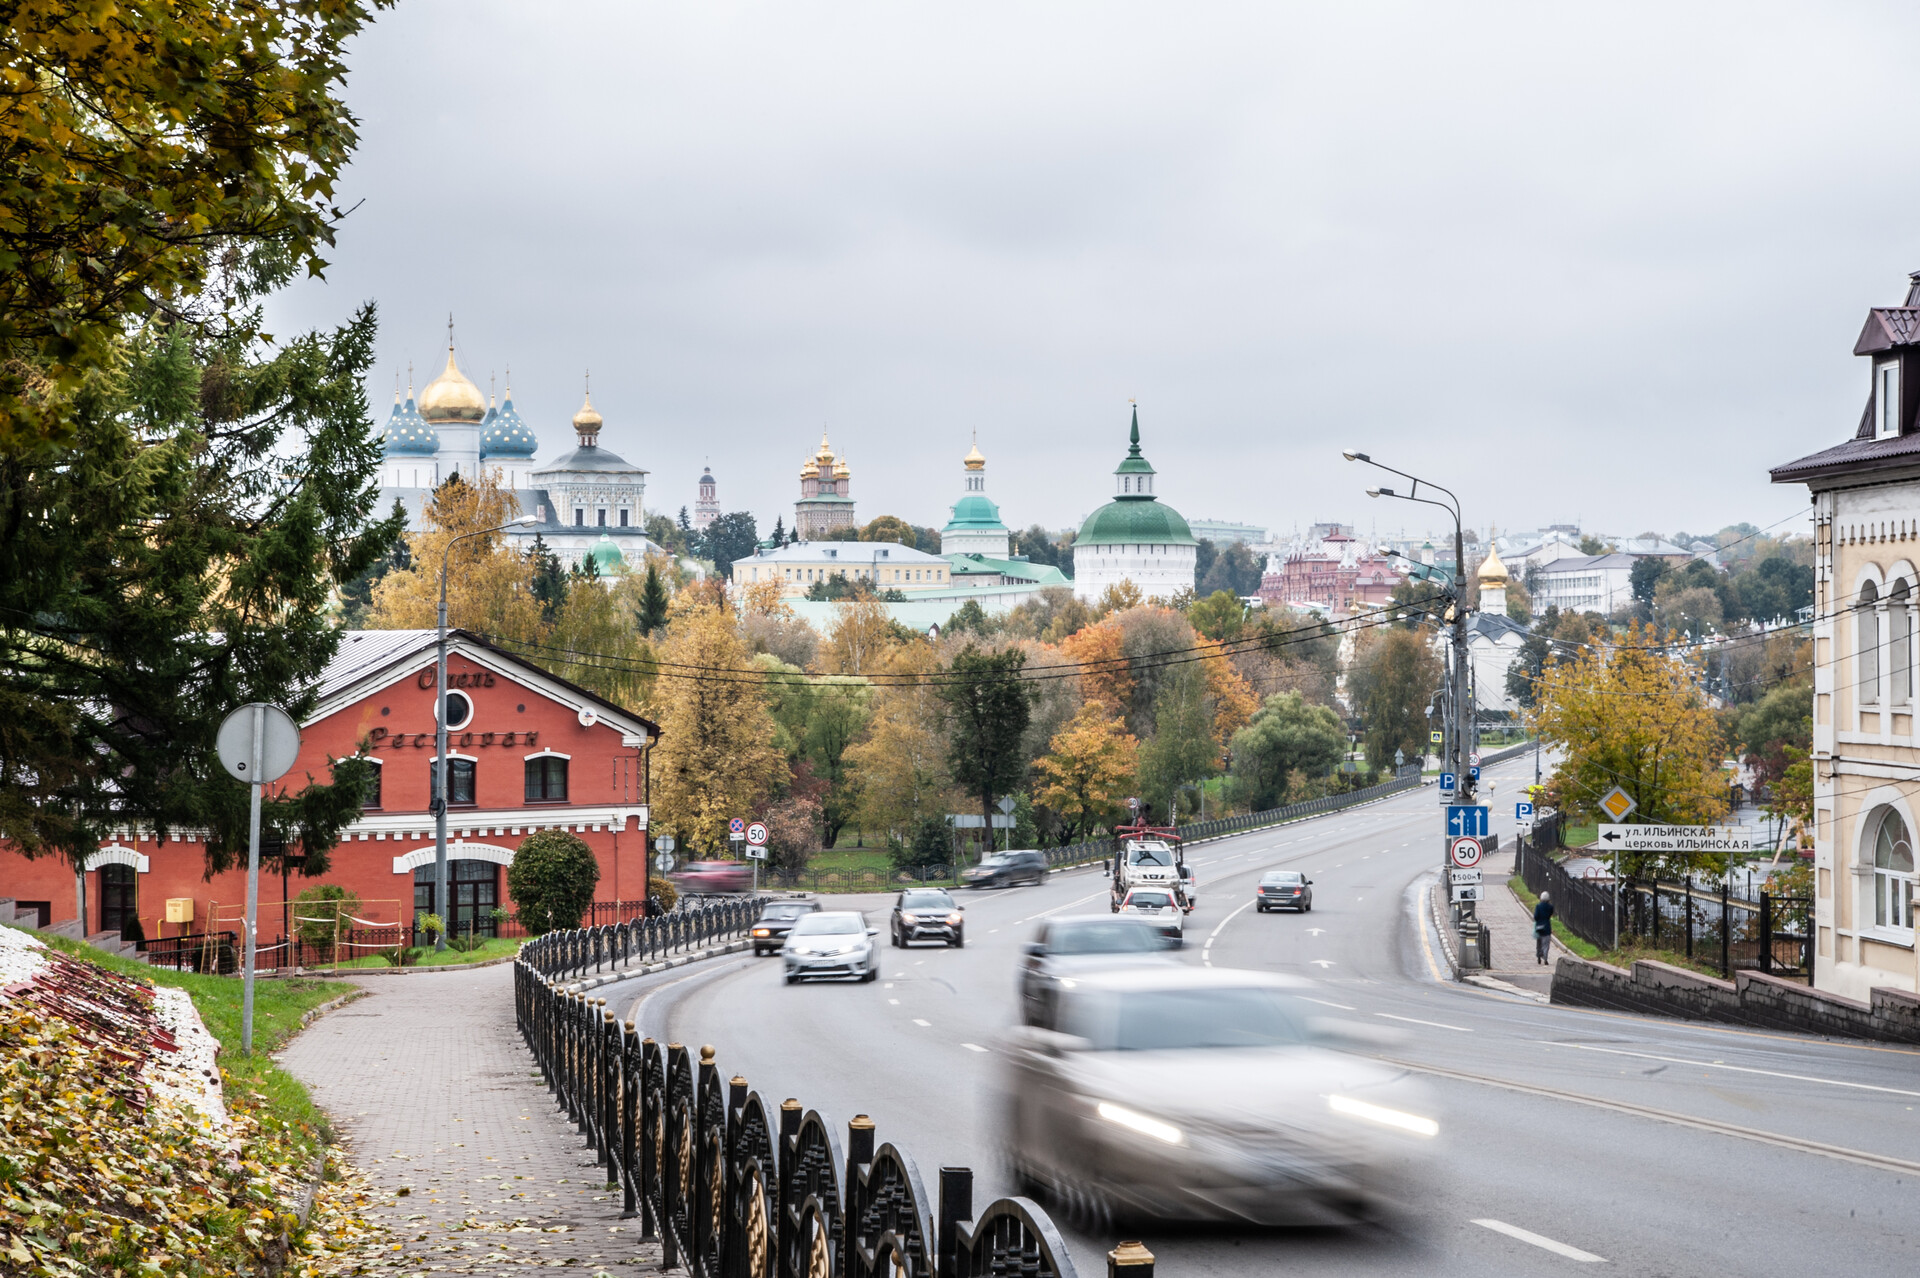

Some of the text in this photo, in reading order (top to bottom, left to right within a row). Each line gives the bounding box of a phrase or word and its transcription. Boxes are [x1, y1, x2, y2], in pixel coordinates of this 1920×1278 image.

[1444, 774, 1454, 788] P
[1519, 804, 1529, 818] P
[750, 829, 765, 840] 50
[1625, 827, 1716, 837] ул. ИЛЬИНСКАЯ
[1625, 839, 1749, 849] церковь ИЛЬИНСКАЯ
[1459, 846, 1476, 859] 50
